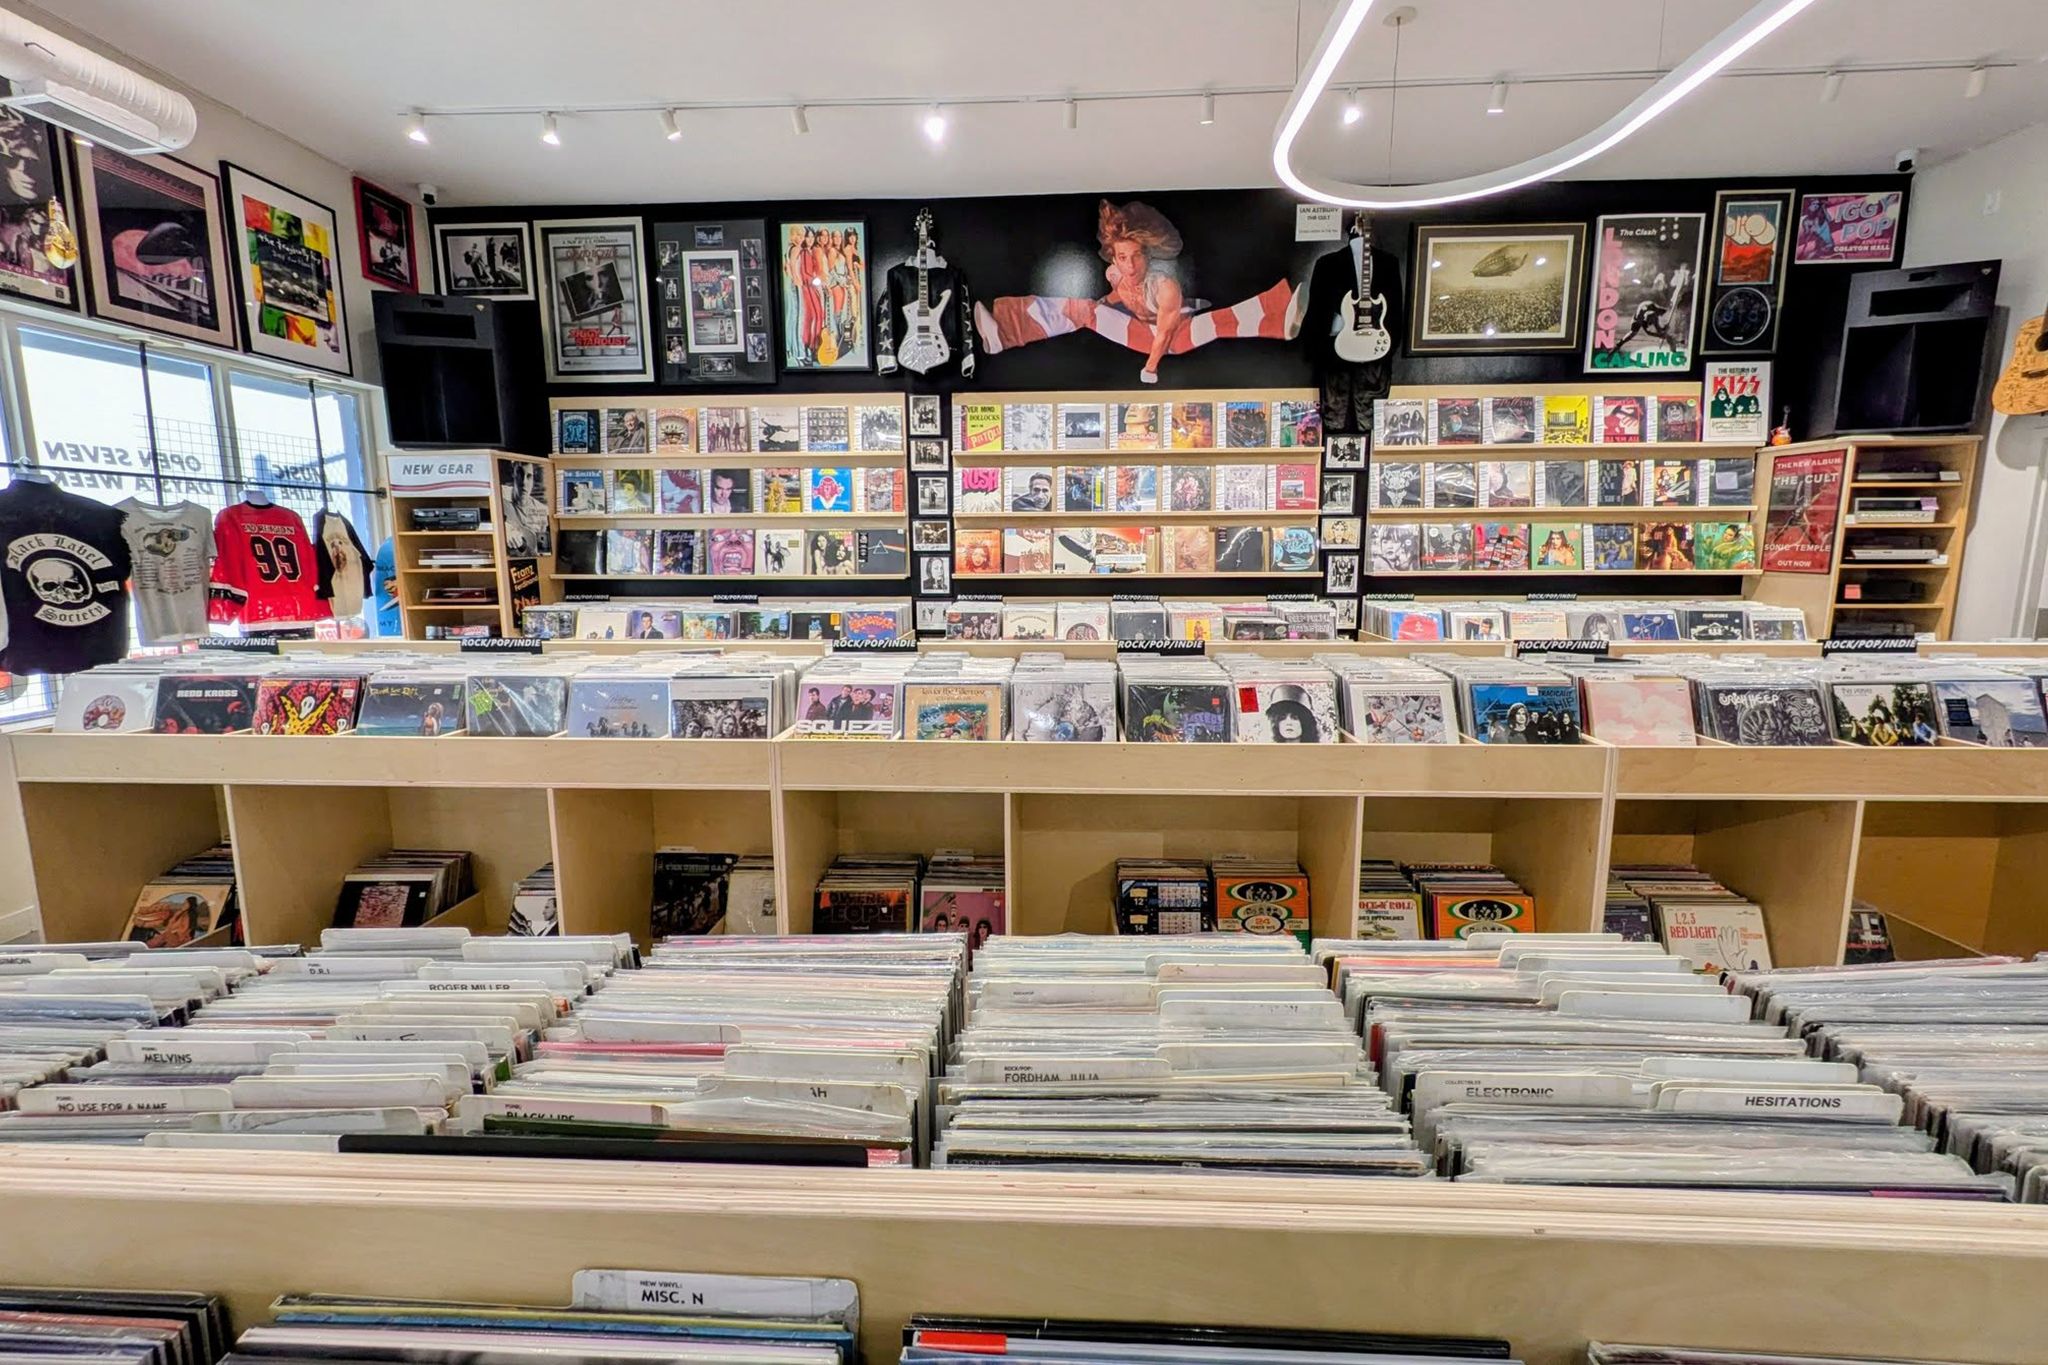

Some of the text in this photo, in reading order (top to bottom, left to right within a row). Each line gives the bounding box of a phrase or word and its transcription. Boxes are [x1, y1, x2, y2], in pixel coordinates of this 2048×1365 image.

[1834, 193, 1899, 223] IGGY
[1635, 228, 1657, 236] Clash
[1840, 217, 1892, 243] POP
[1594, 351, 1687, 368] CALLING
[1713, 376, 1760, 395] KISS
[1811, 458, 1841, 466] ALBUM
[402, 464, 474, 475] NEW GEAR
[1774, 473, 1838, 486] THE CULT
[53, 535, 105, 565] Label
[1795, 543, 1831, 552] TEMPLE
[250, 534, 302, 583] 99
[511, 565, 534, 583] Franz
[40, 604, 104, 623] Society
[199, 637, 277, 646] ROCK/POP/INDIE
[462, 639, 541, 648] ROCK/POP/INDIE
[833, 640, 917, 648] ROCK/POP/INDIE
[1118, 640, 1204, 649] ROCK/POP/INDIE
[1518, 641, 1608, 650] ROCK/POP/INDIE
[1824, 640, 1918, 649] ROCK/POP/INDIE
[204, 690, 239, 698] KROSS
[1134, 898, 1145, 906] 12
[1135, 924, 1144, 933] 14
[1670, 926, 1717, 939] RED LIGHT
[144, 1054, 192, 1063] MELVINS
[1466, 1087, 1554, 1098] ELECTRONIC
[58, 1103, 75, 1112] NO
[78, 1103, 98, 1112] USE
[102, 1103, 122, 1111] FOR
[1744, 1096, 1842, 1109] HESITATIONS
[641, 1290, 704, 1305] MISC. N
